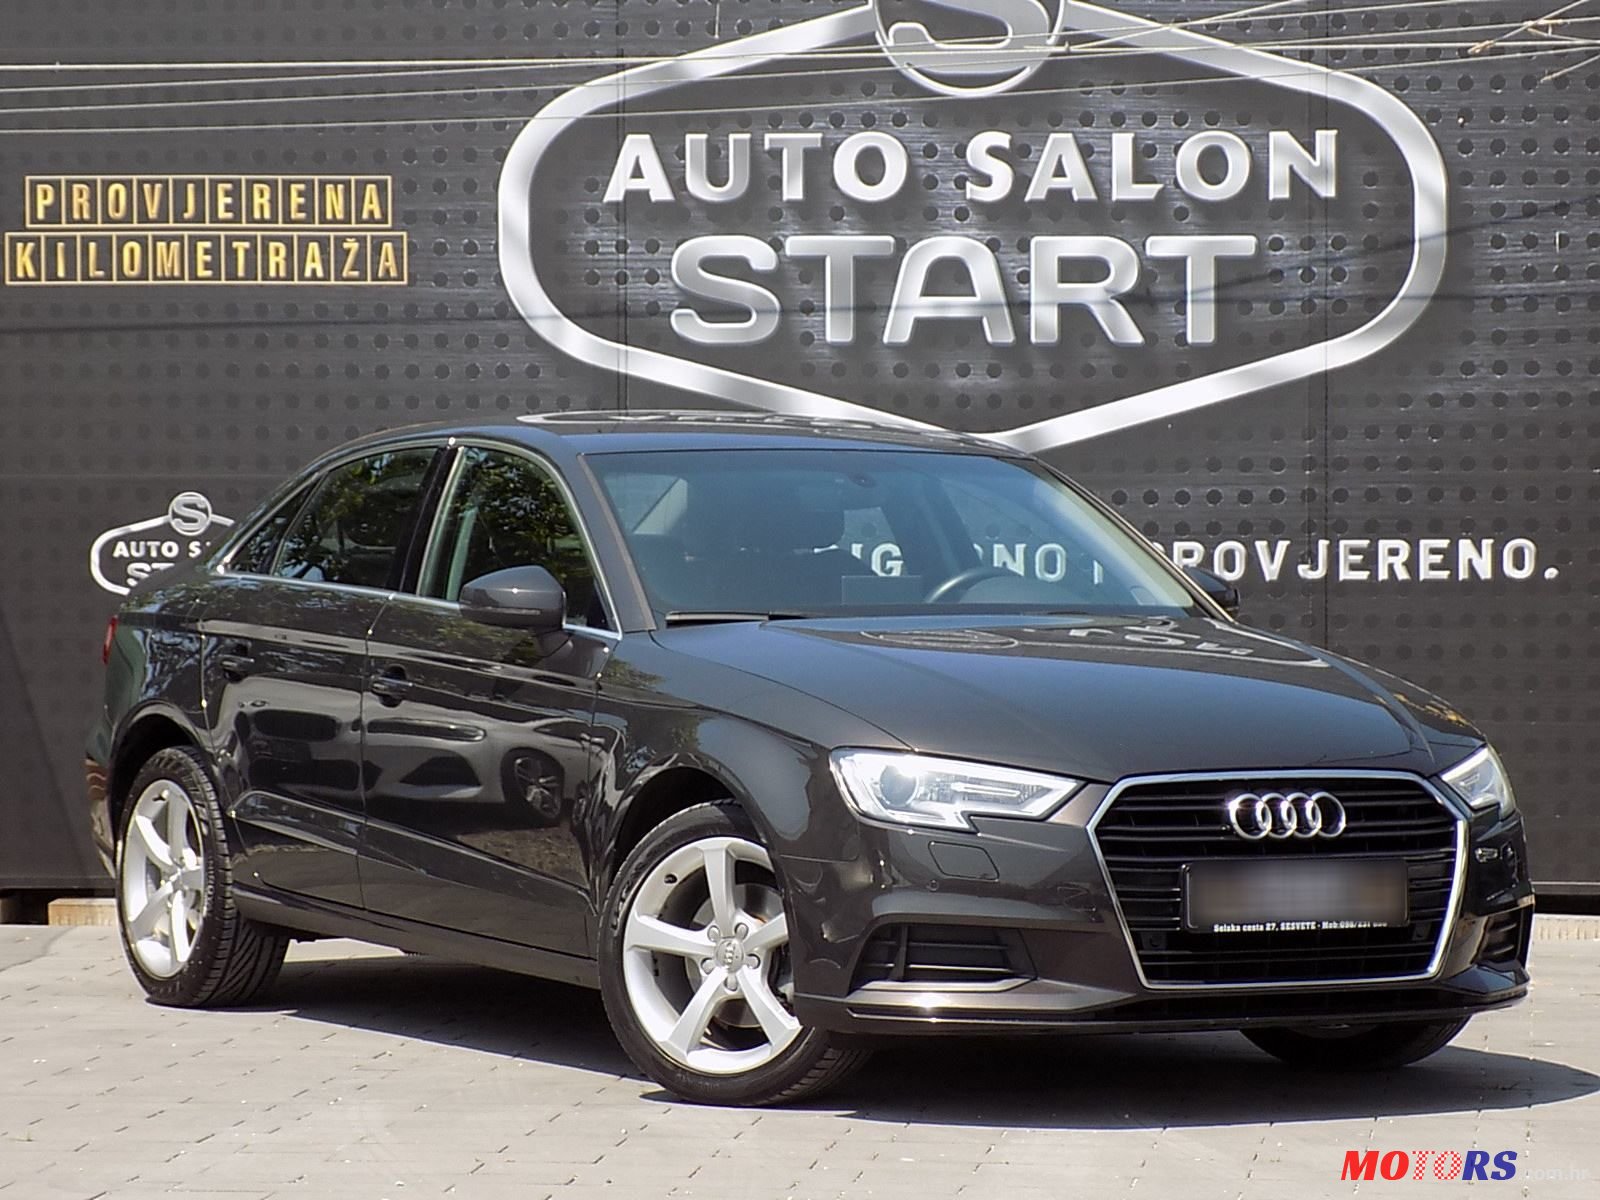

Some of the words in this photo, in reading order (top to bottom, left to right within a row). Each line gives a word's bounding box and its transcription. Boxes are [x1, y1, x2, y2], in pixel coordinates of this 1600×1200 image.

[602, 132, 909, 202] AUTO
[964, 128, 1339, 202] SALON
[35, 183, 383, 220] PROVJERENA
[15, 237, 399, 278] KILOMETRAŽA
[669, 234, 1257, 345] START
[112, 541, 180, 558] AUTO
[1152, 538, 1560, 583] ROVJERENO.
